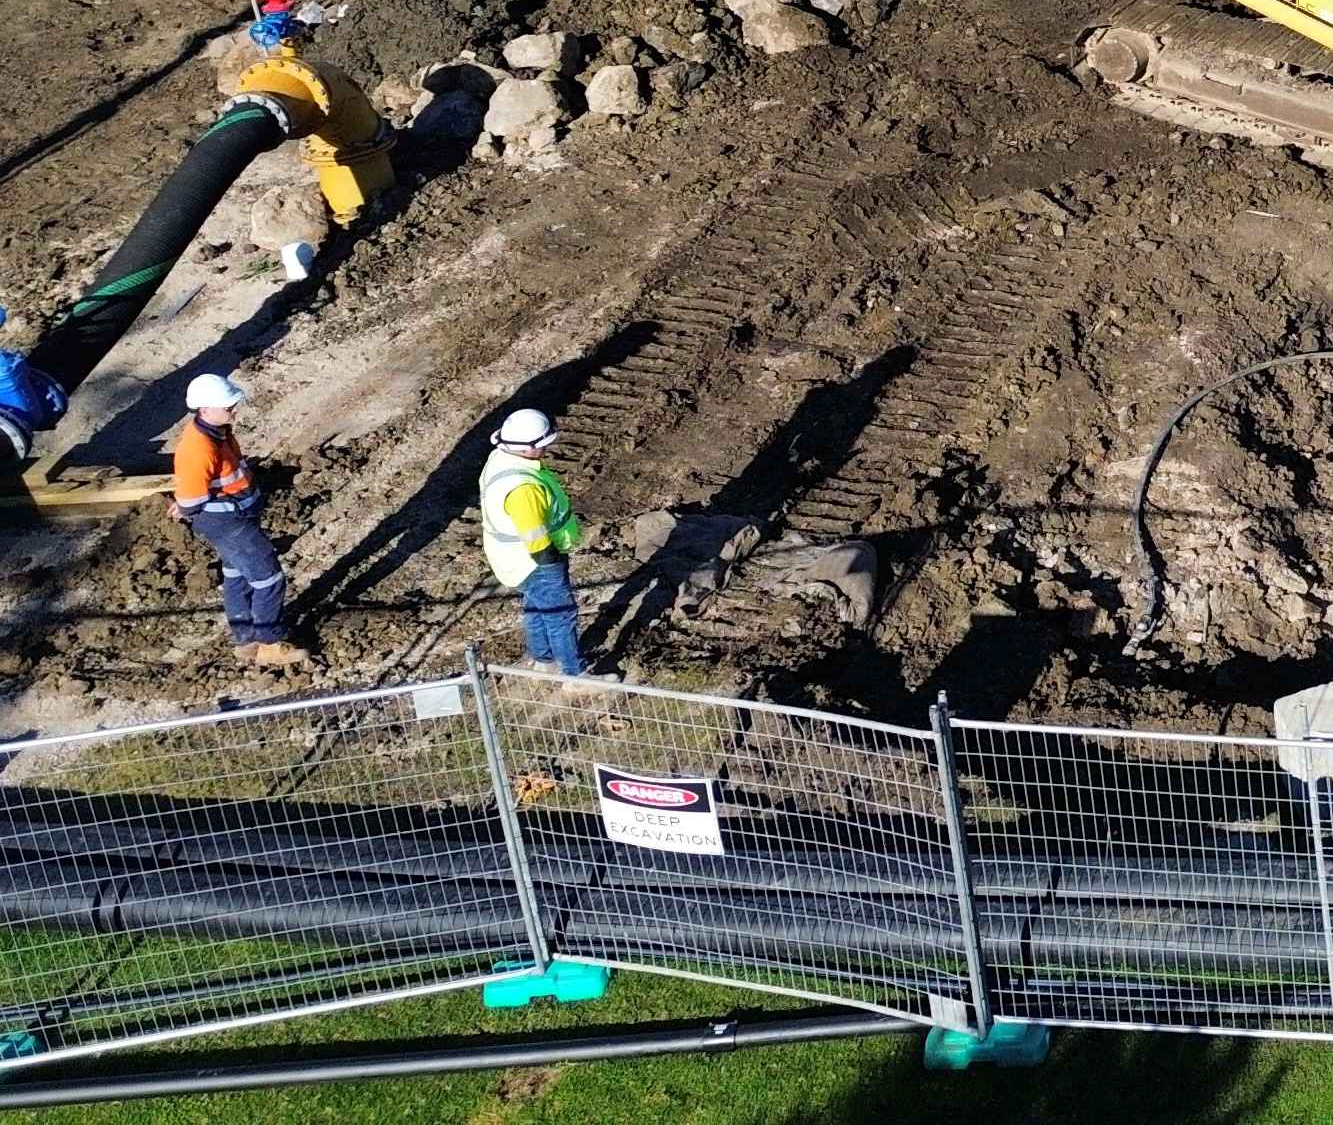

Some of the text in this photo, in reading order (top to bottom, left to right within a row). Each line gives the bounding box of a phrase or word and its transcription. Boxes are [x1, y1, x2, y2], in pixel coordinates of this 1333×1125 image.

[619, 783, 686, 804] DANGER
[634, 811, 680, 827] DEEP
[609, 821, 717, 846] EXCAVATION
